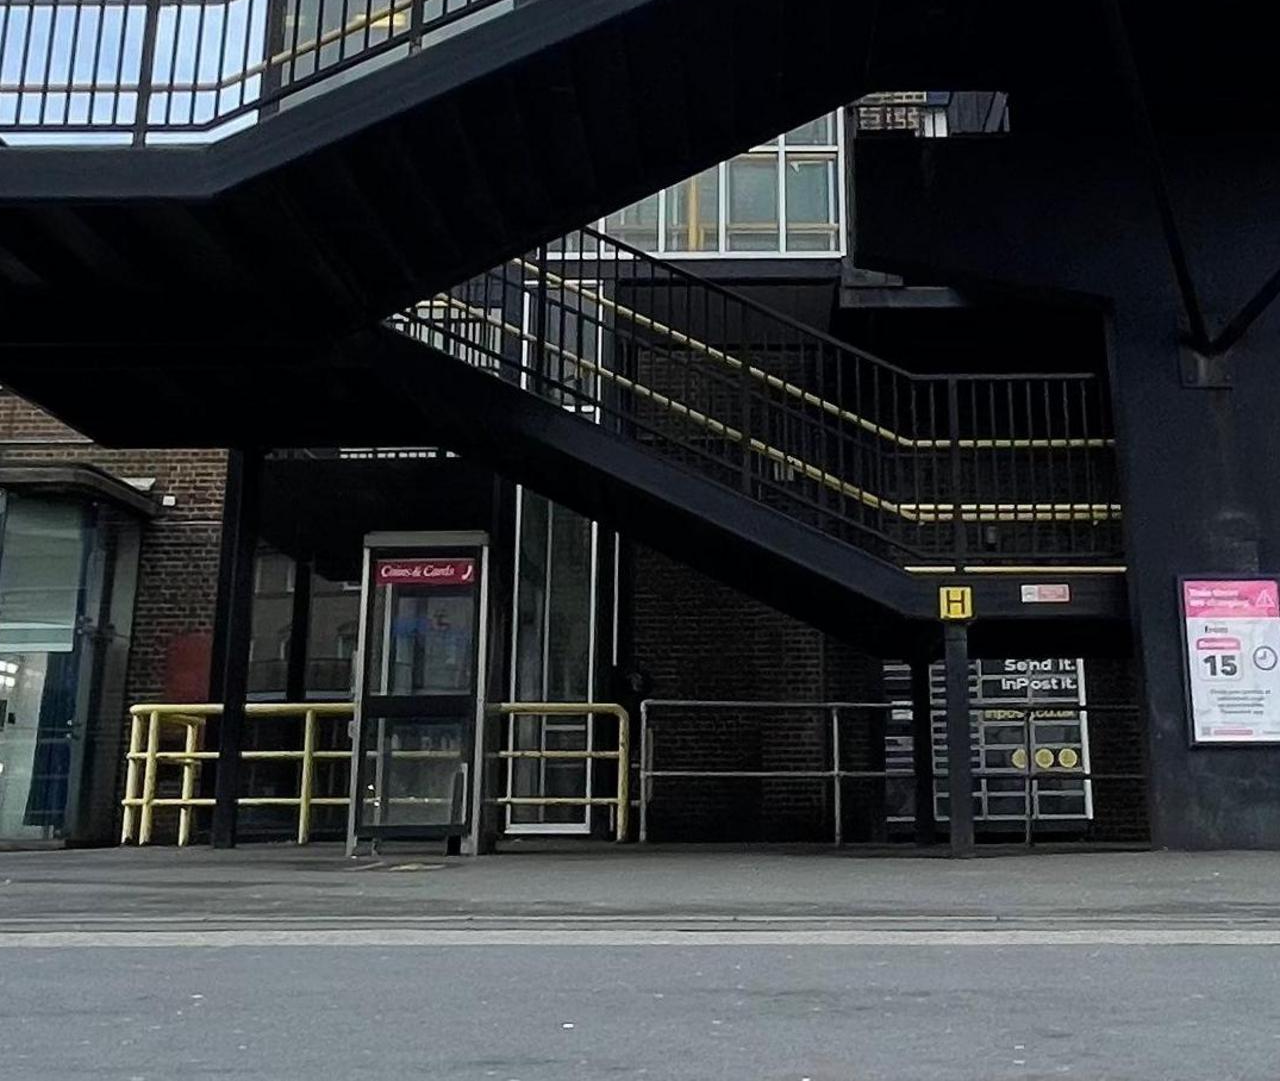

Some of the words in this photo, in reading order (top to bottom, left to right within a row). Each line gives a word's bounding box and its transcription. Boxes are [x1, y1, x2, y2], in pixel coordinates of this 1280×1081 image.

[946, 590, 965, 615] H
[1004, 659, 1052, 671] Send
[1203, 655, 1237, 676] 15
[1001, 677, 1058, 690] InPost
